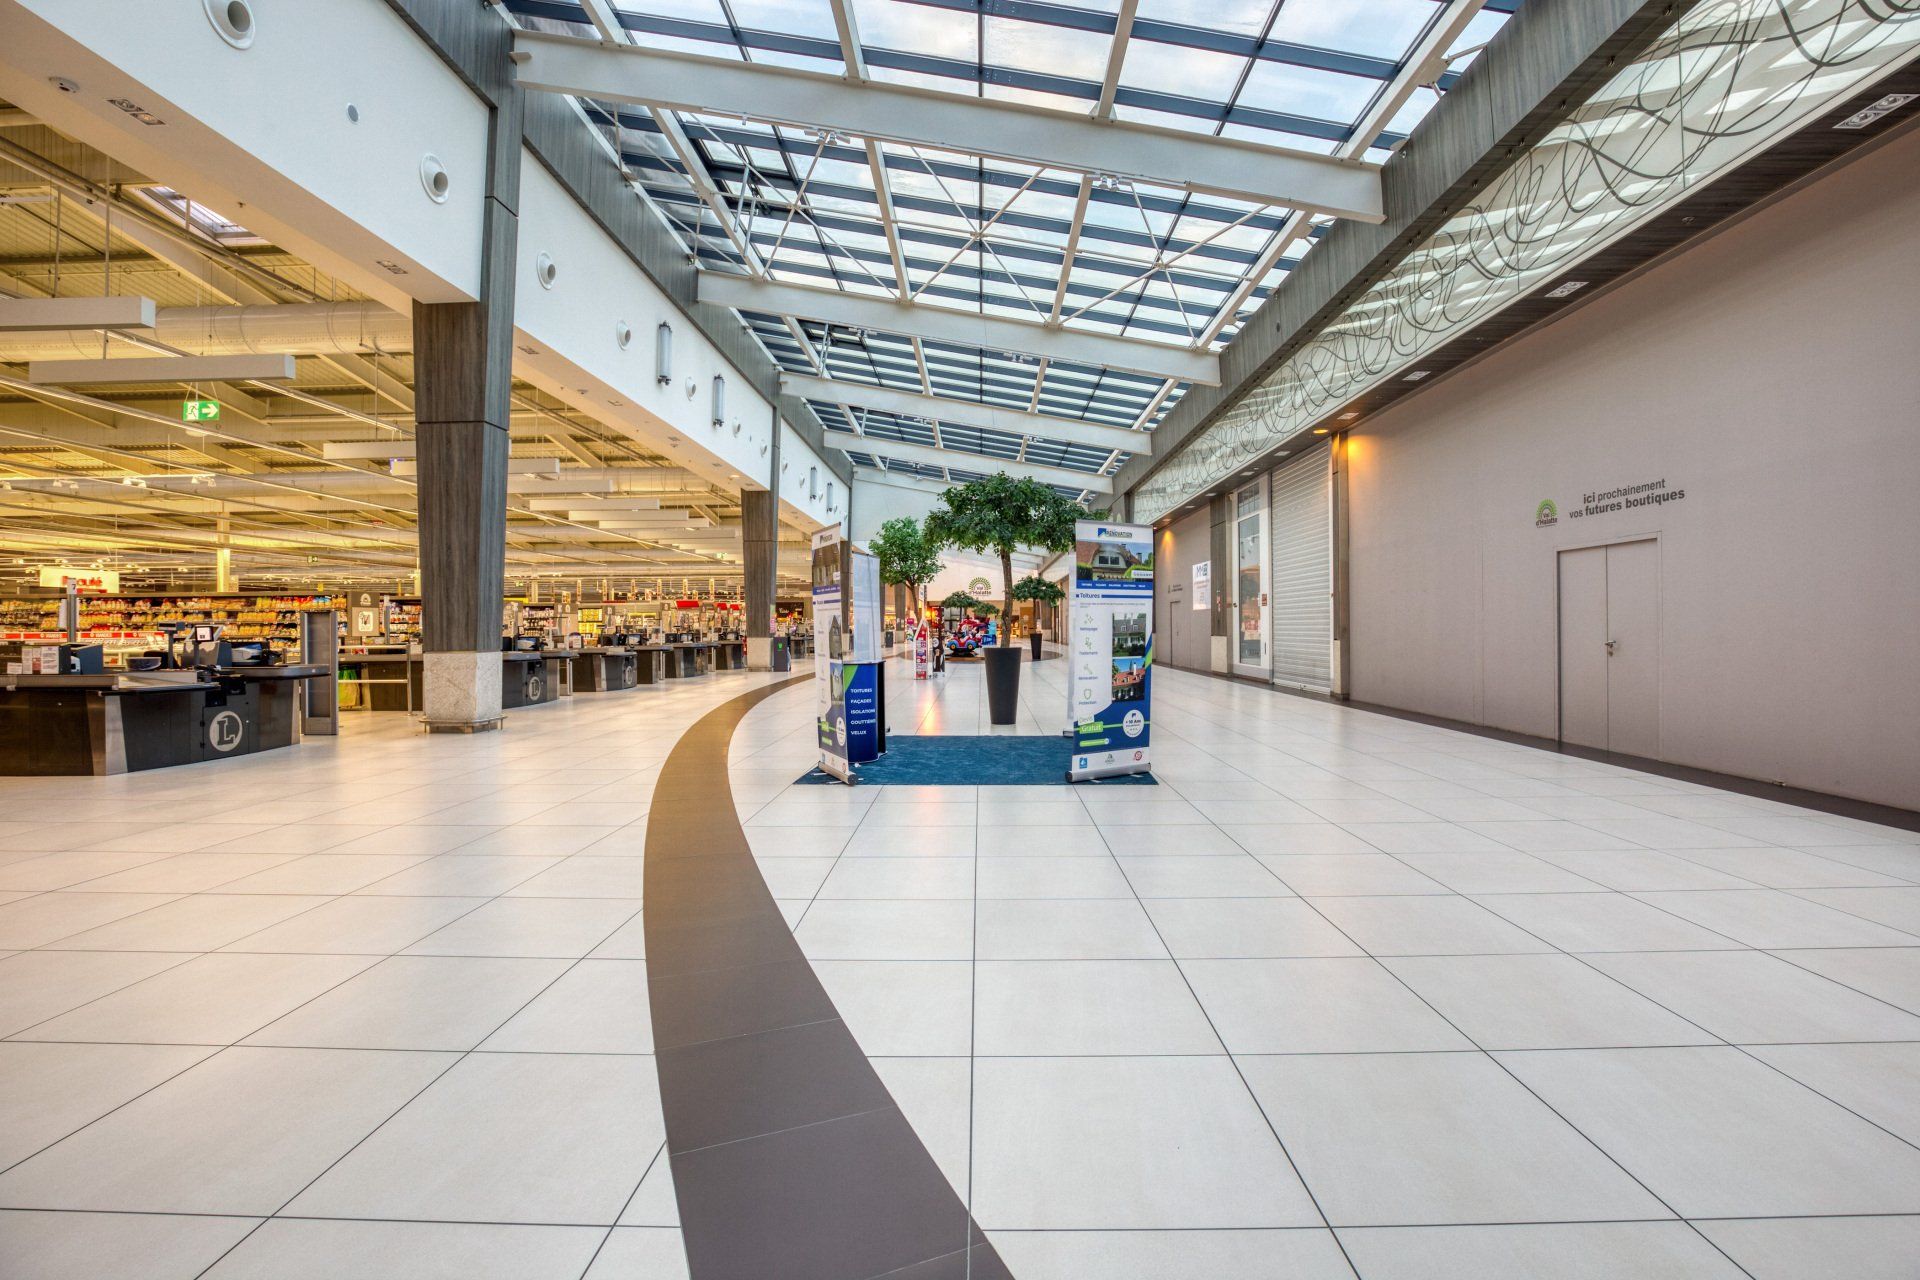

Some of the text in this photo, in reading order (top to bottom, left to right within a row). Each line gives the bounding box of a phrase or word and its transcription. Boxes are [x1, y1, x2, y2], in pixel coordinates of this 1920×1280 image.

[1569, 489, 1685, 519] vos futures boutiques
[1583, 478, 1666, 504] ici prochainement
